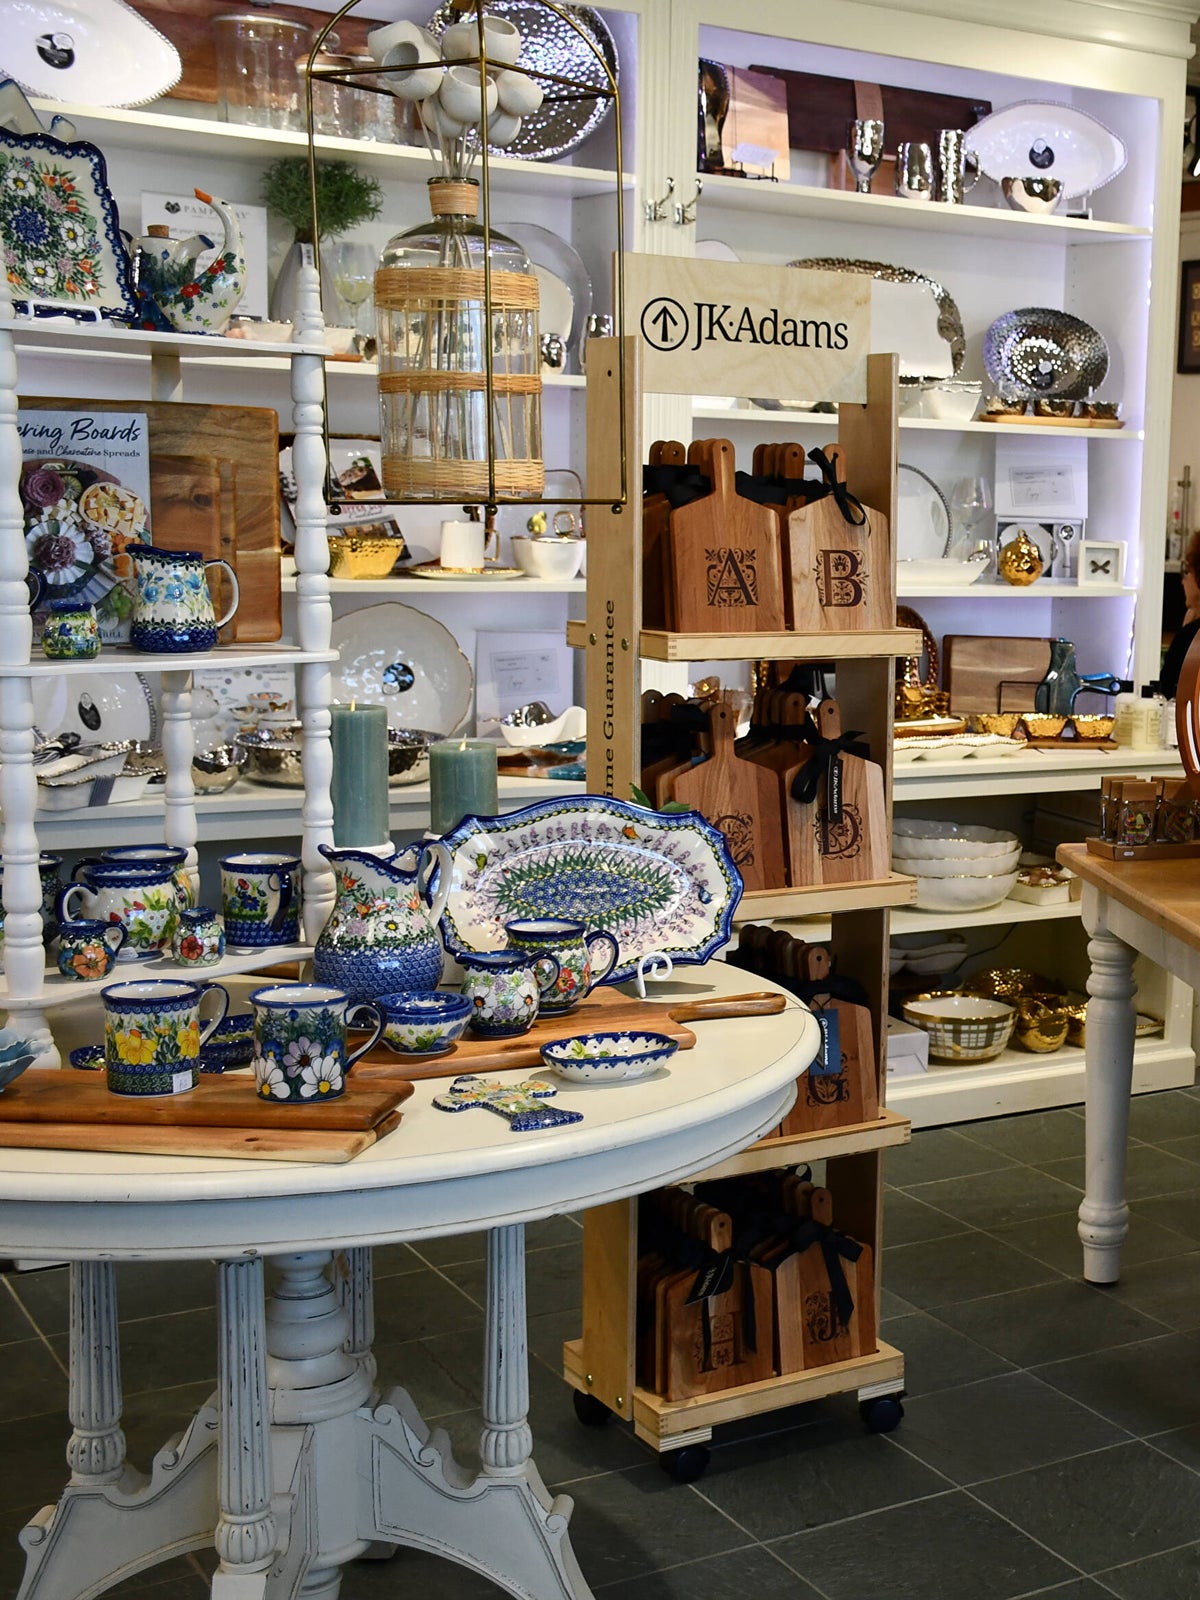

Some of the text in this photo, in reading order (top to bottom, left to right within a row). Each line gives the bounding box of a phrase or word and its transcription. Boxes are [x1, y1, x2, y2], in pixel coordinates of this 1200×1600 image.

[184, 205, 219, 215] PAMP
[17, 417, 141, 449] ering Boards
[103, 450, 141, 458] Spreads
[707, 548, 759, 606] A
[819, 549, 864, 607] B
[603, 600, 615, 740] Guarantee
